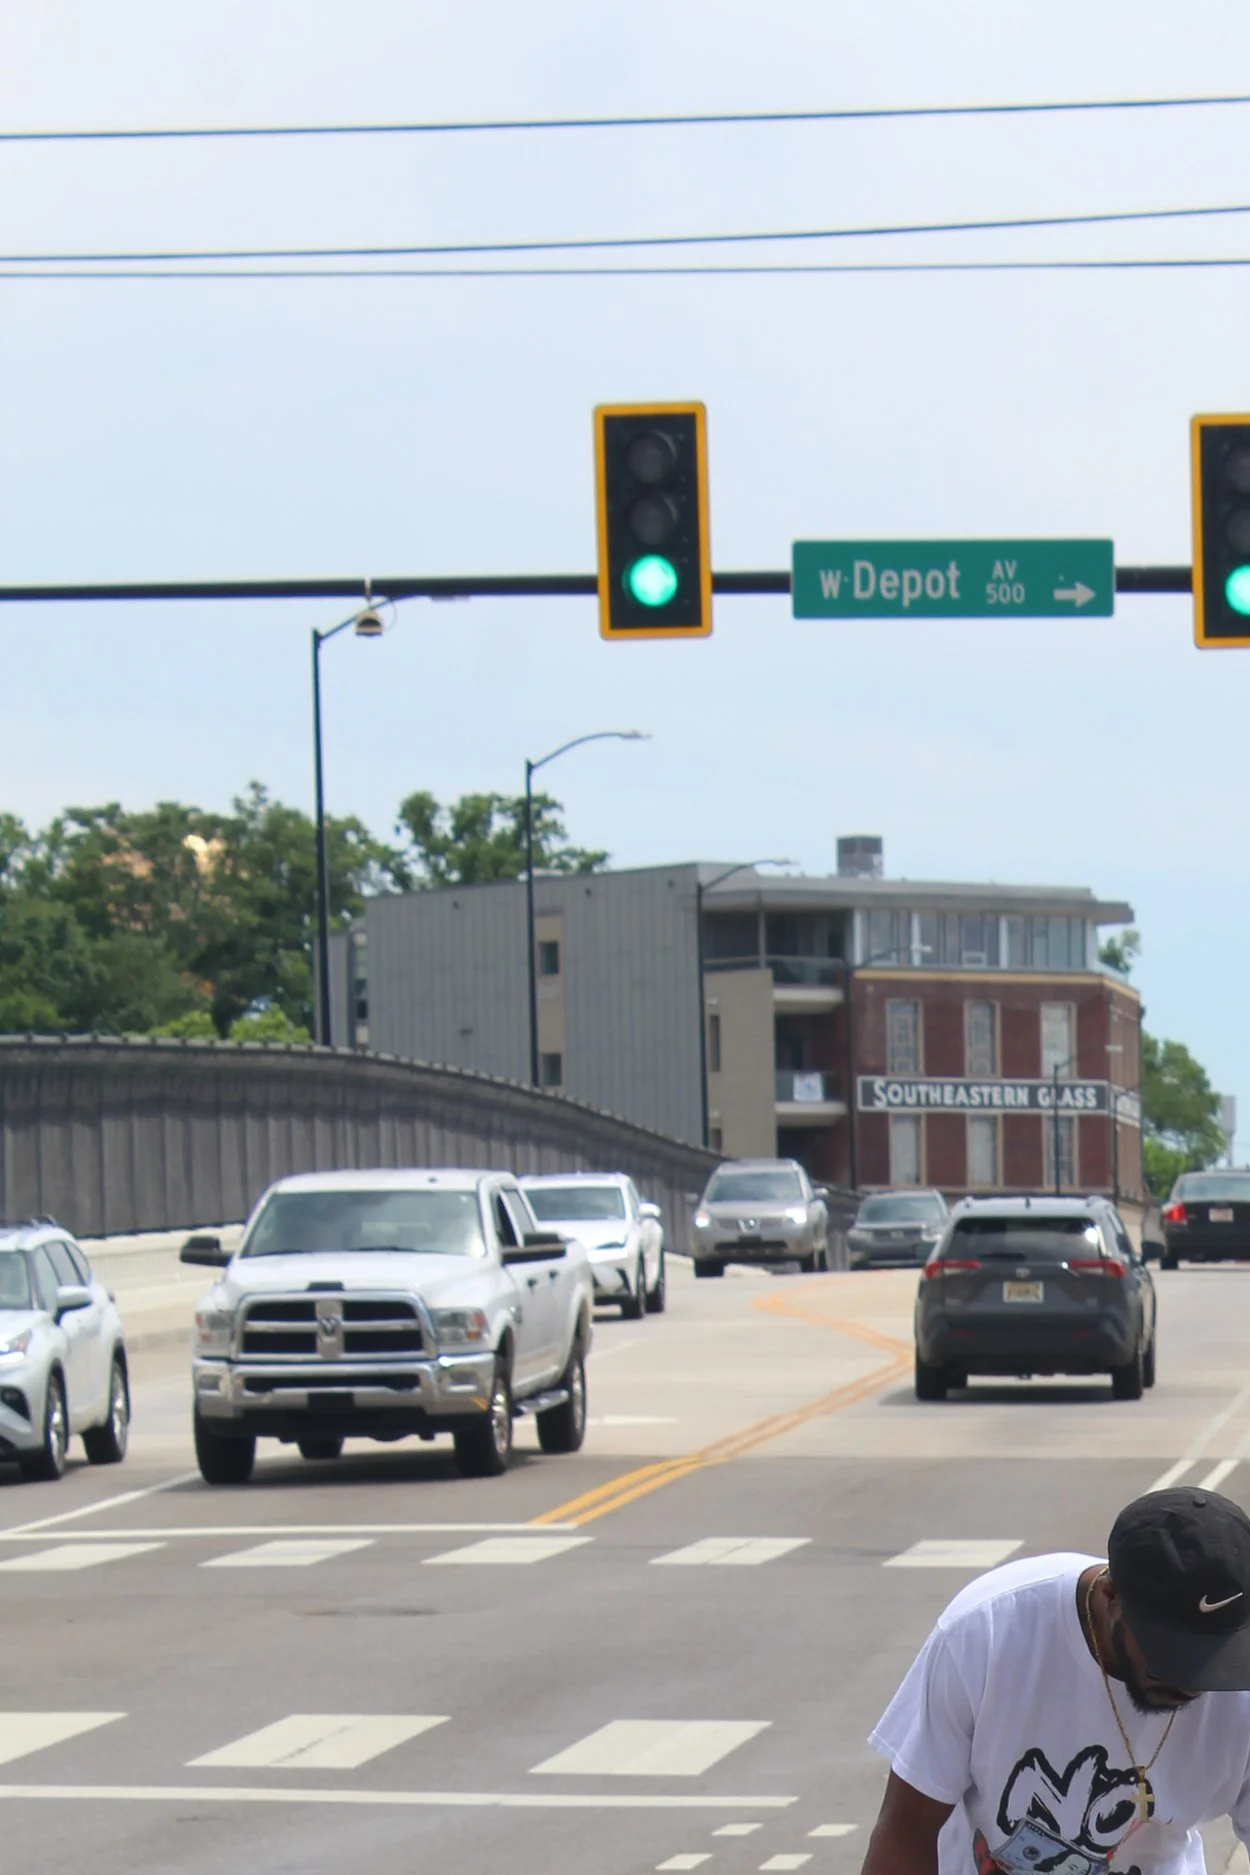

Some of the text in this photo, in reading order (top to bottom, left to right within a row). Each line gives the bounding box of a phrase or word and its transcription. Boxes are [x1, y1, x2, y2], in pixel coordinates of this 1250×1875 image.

[991, 560, 1017, 580] AV
[853, 560, 960, 608] Depot
[985, 583, 1026, 604] 500
[873, 1080, 1029, 1108] SOUTHEASTERN
